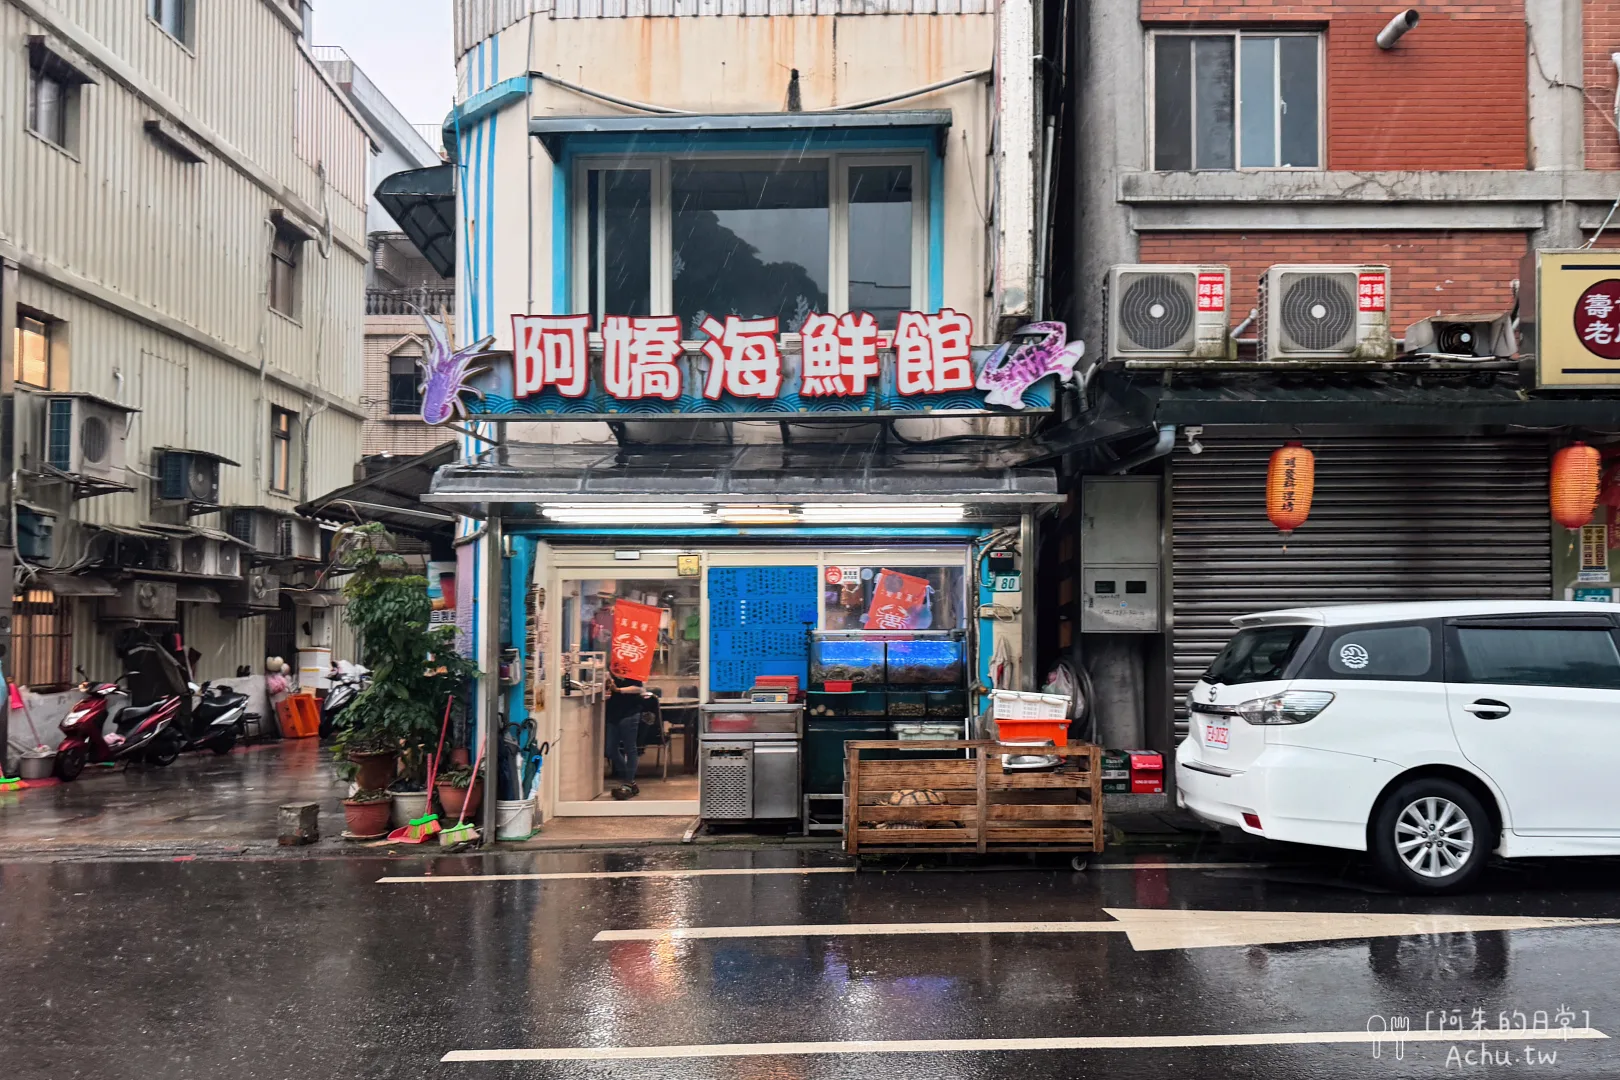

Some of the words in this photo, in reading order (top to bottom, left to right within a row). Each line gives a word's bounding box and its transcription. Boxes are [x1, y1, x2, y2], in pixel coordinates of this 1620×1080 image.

[1584, 293, 1620, 319] 壽
[1584, 320, 1620, 345] 老
[509, 308, 974, 400] 阿嬌海鮮館
[1001, 578, 1015, 589] 80
